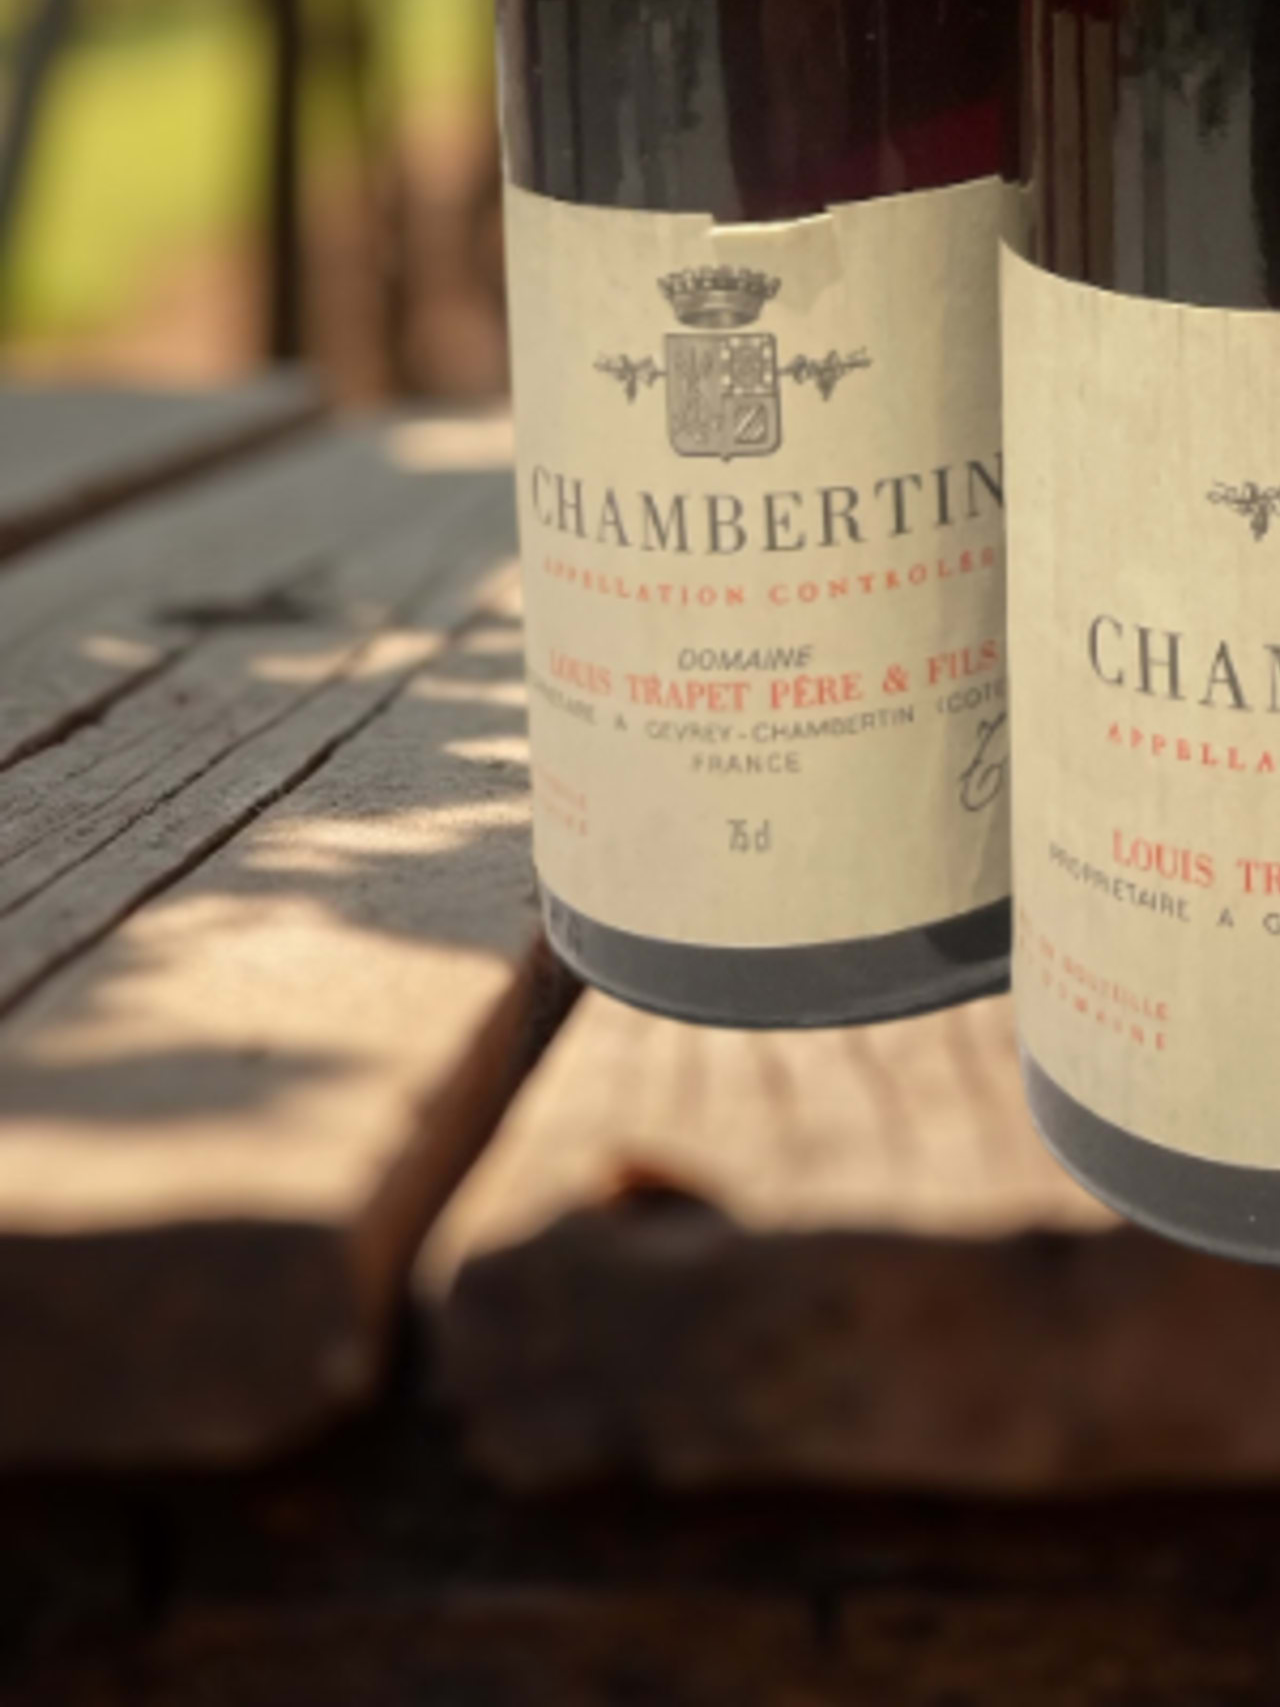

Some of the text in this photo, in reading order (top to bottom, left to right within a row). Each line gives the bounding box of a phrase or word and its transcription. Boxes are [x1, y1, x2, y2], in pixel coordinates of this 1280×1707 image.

[531, 449, 1004, 556] CHAMBERTIN
[626, 673, 750, 712] TRAPET
[882, 663, 908, 694] &
[926, 639, 999, 686] FILS
[678, 644, 815, 671] DOMAINE
[691, 751, 803, 775] FRANCE
[1111, 827, 1217, 890] LOUIS
